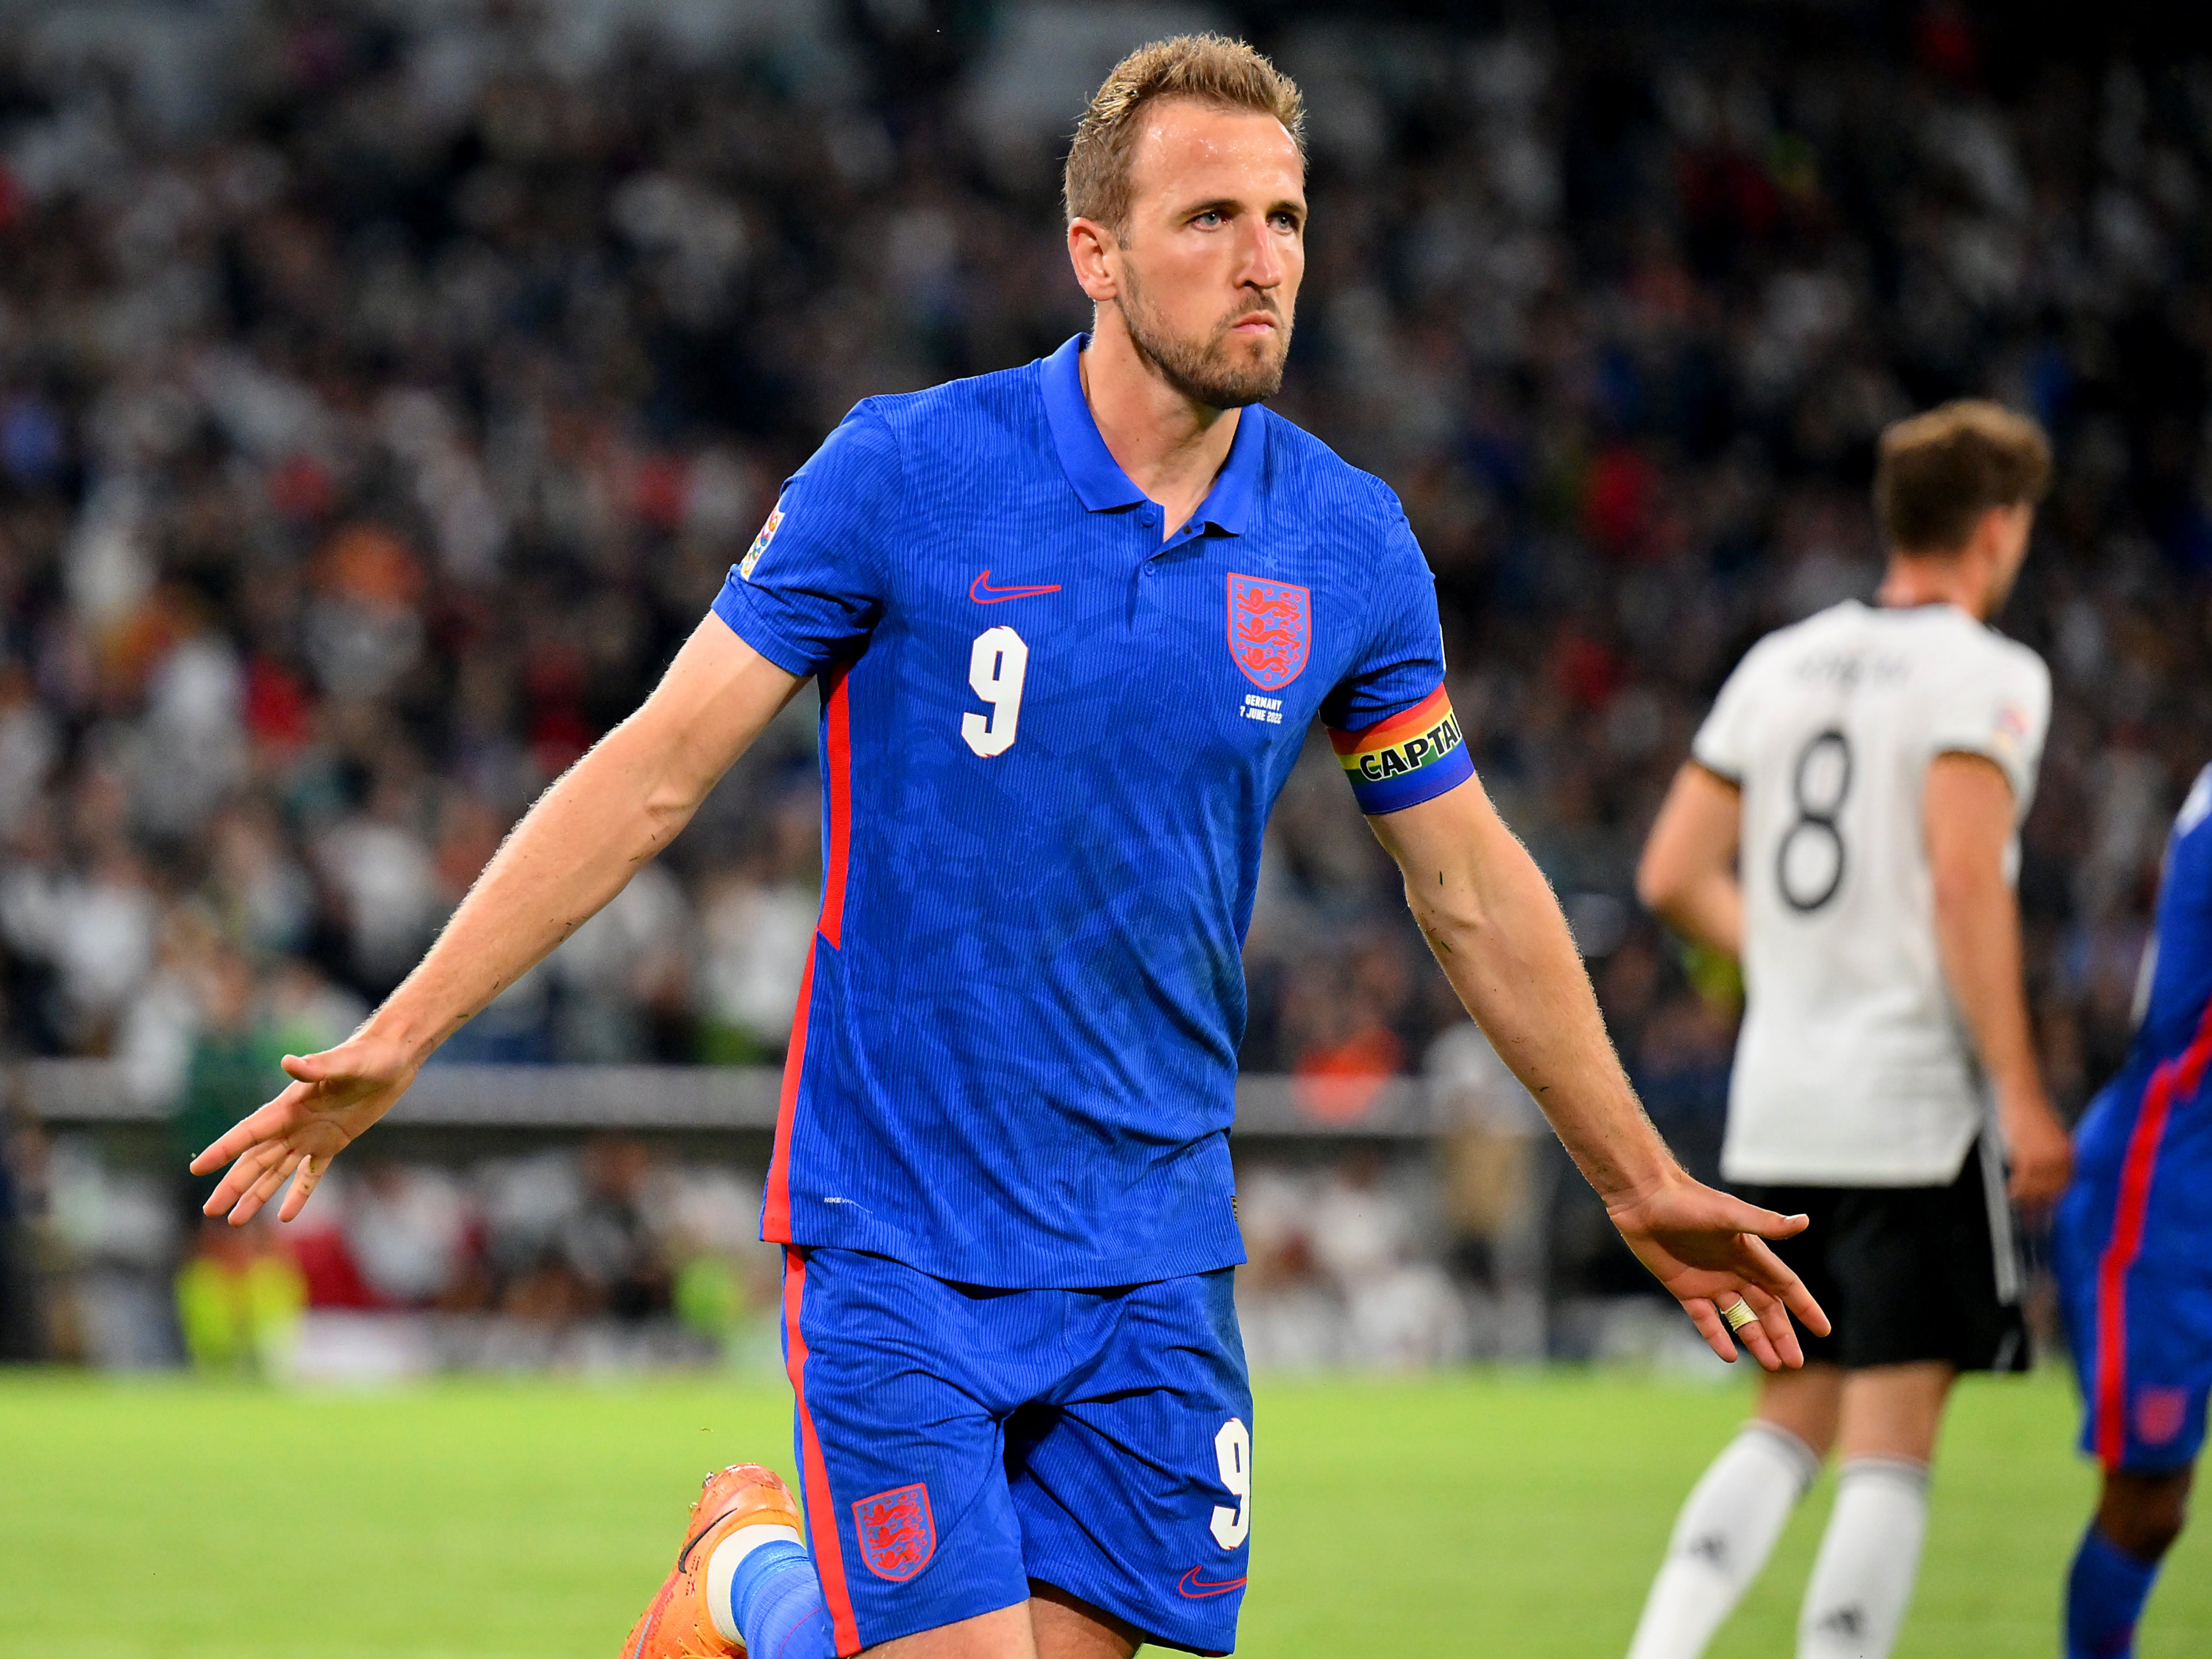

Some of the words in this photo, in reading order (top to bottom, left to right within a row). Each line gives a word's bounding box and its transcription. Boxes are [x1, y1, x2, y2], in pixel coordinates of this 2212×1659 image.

[961, 625, 1029, 758] 9
[1240, 705, 1246, 717] 7
[1246, 707, 1266, 721] JUNE
[1267, 711, 1282, 724] 2022
[1245, 694, 1282, 711] GERMANY
[1360, 712, 1462, 781] CAPTAI
[1775, 729, 1853, 914] 8
[1209, 1417, 1250, 1551] 9
